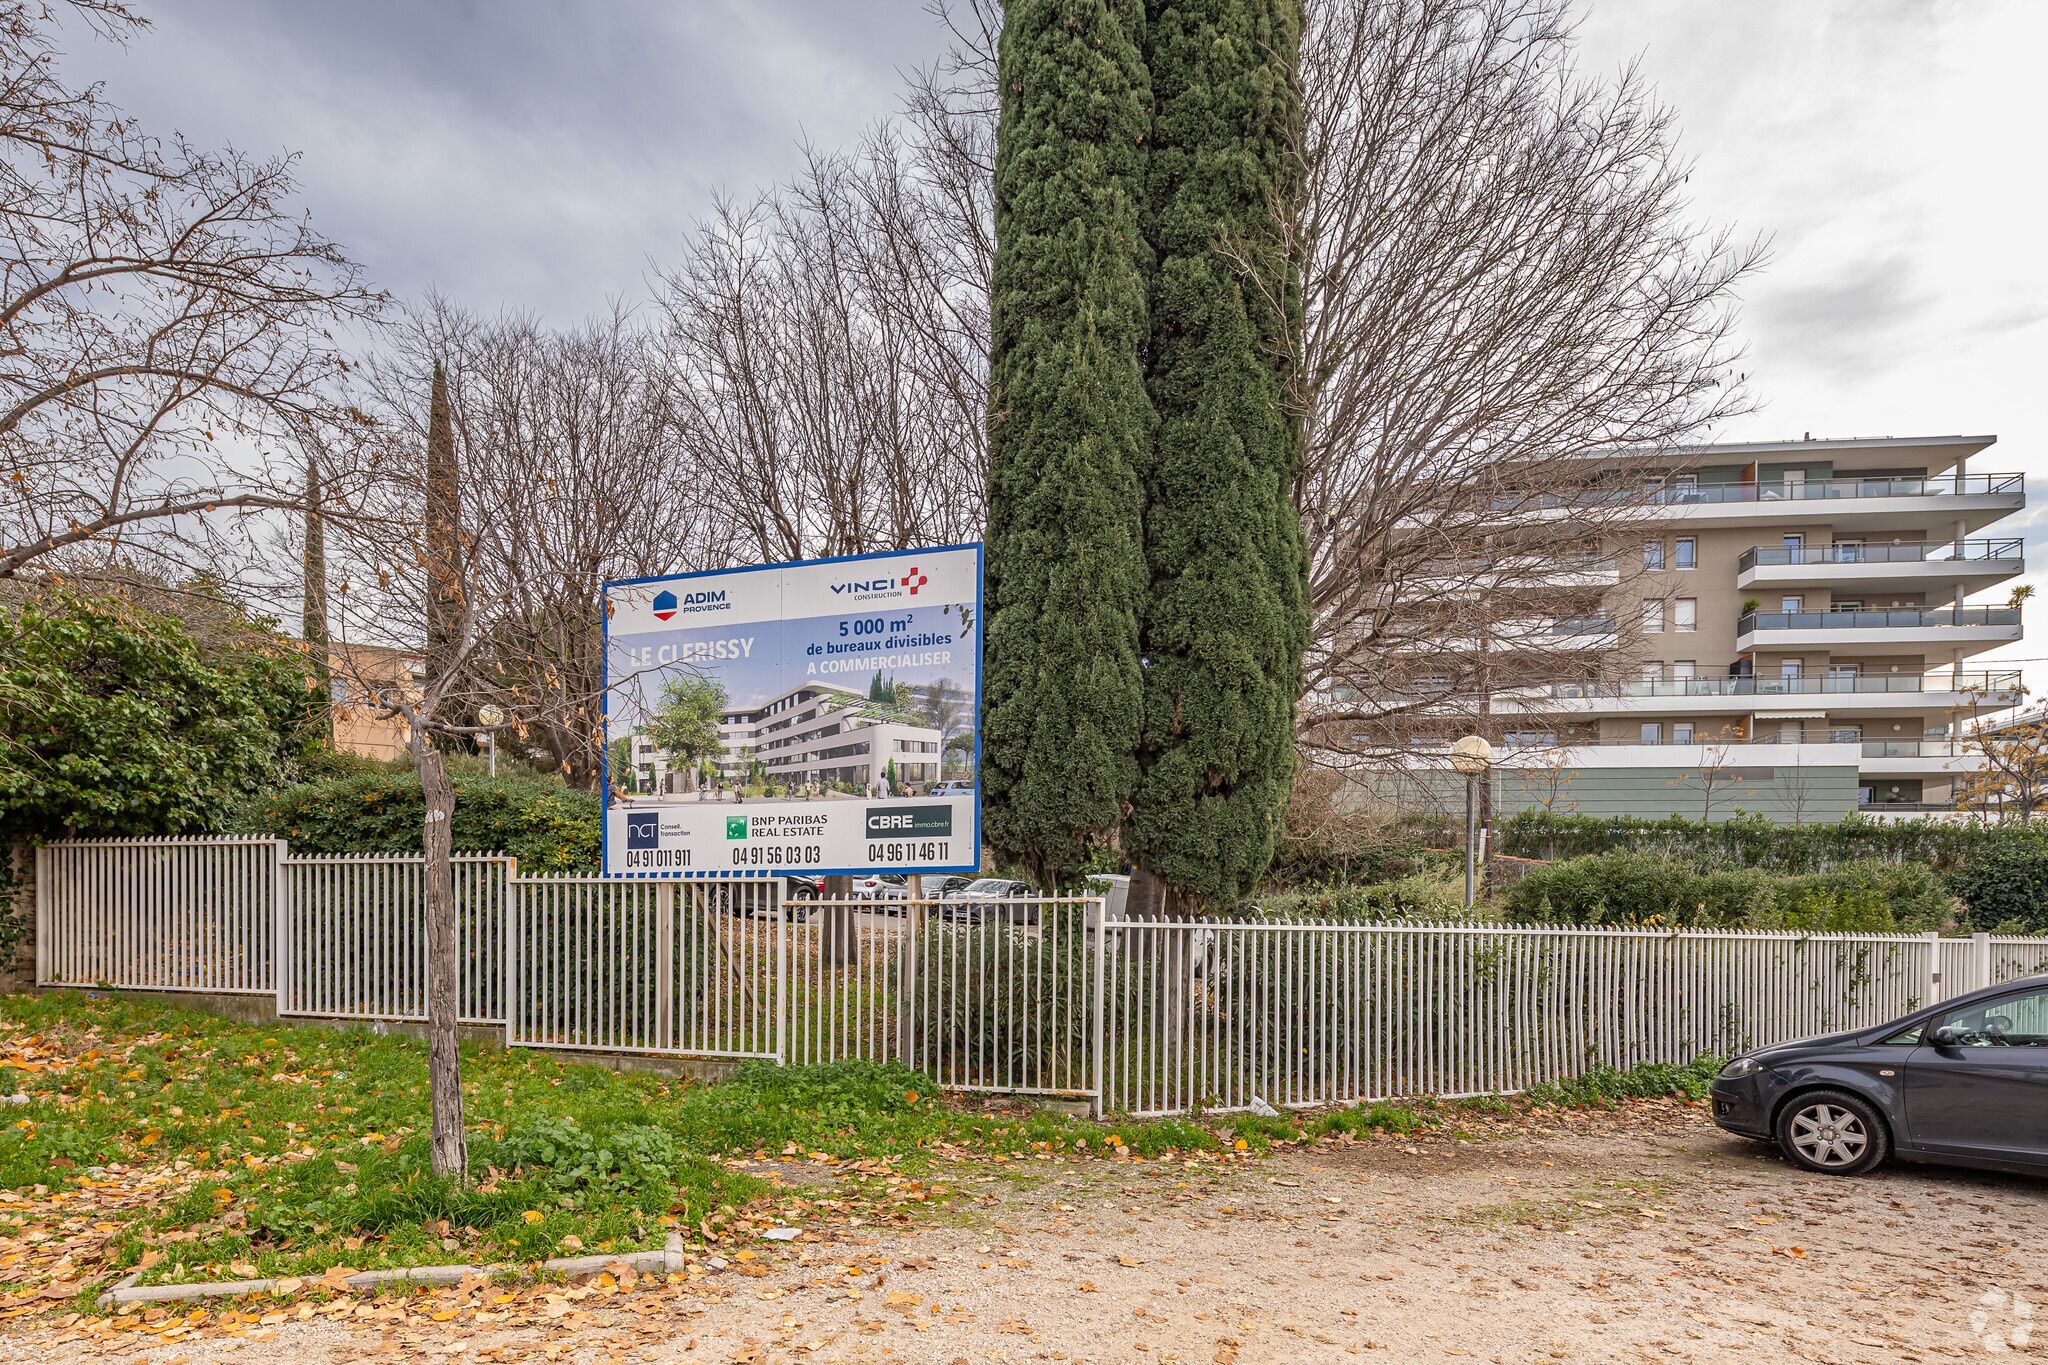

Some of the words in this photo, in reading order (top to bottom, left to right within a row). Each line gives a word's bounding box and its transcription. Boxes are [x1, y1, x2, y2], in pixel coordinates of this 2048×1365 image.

[830, 578, 895, 595] VINCI
[683, 590, 726, 605] ADIM
[854, 591, 902, 601] CONSTRUCTION
[683, 602, 731, 613] PROVENCE
[839, 621, 849, 637] 5
[853, 618, 885, 636] 000
[630, 646, 652, 667] LE
[657, 637, 755, 665] CLERISSY
[806, 643, 823, 656] de
[827, 640, 881, 654] bureaux
[885, 632, 952, 649] divisibles
[806, 662, 817, 675] A
[820, 651, 951, 674] COMMERCIALISER
[751, 816, 775, 826] BNP
[778, 814, 828, 825] PARIBAS
[868, 814, 913, 829] CBRE
[914, 820, 949, 828] immo.cbre.fr
[751, 828, 780, 837] REAL
[783, 826, 824, 836] ESTATE
[627, 850, 640, 867] 04
[643, 850, 654, 867] 91
[656, 849, 672, 867] 011
[675, 849, 691, 866] 911
[733, 847, 747, 865] 04
[751, 847, 763, 864] 91
[767, 846, 782, 864] 56
[786, 846, 801, 864] 03
[805, 845, 820, 864] 03
[868, 843, 884, 862] 04
[887, 843, 903, 862] 96
[906, 843, 916, 861] 11
[919, 842, 935, 861] 46
[938, 842, 948, 860] 11
